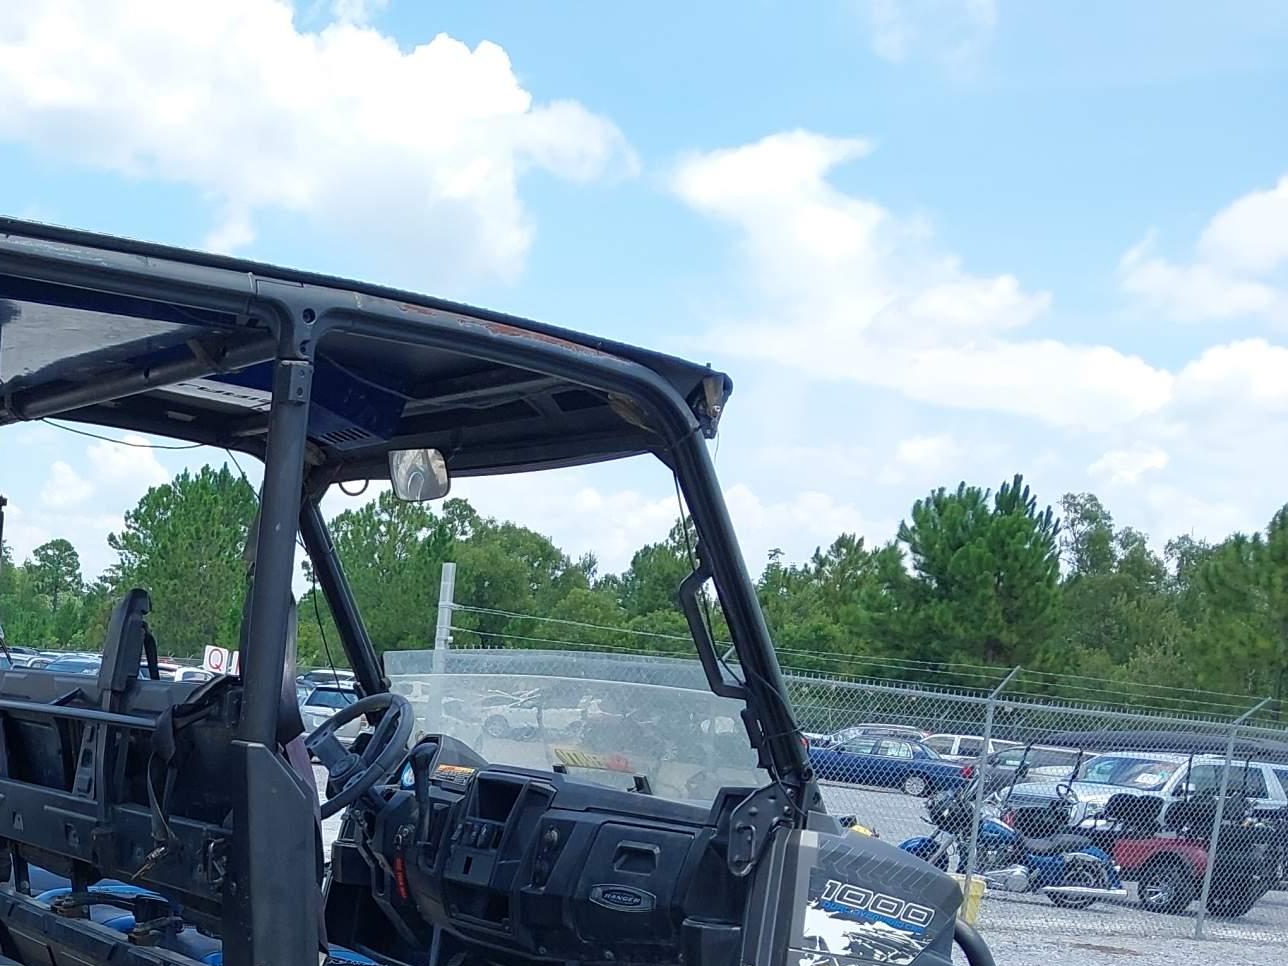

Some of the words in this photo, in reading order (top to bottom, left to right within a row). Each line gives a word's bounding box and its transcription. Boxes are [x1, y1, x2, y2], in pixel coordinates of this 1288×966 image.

[208, 648, 223, 671] Q
[603, 893, 641, 903] RANGER
[821, 879, 935, 928] 1000
